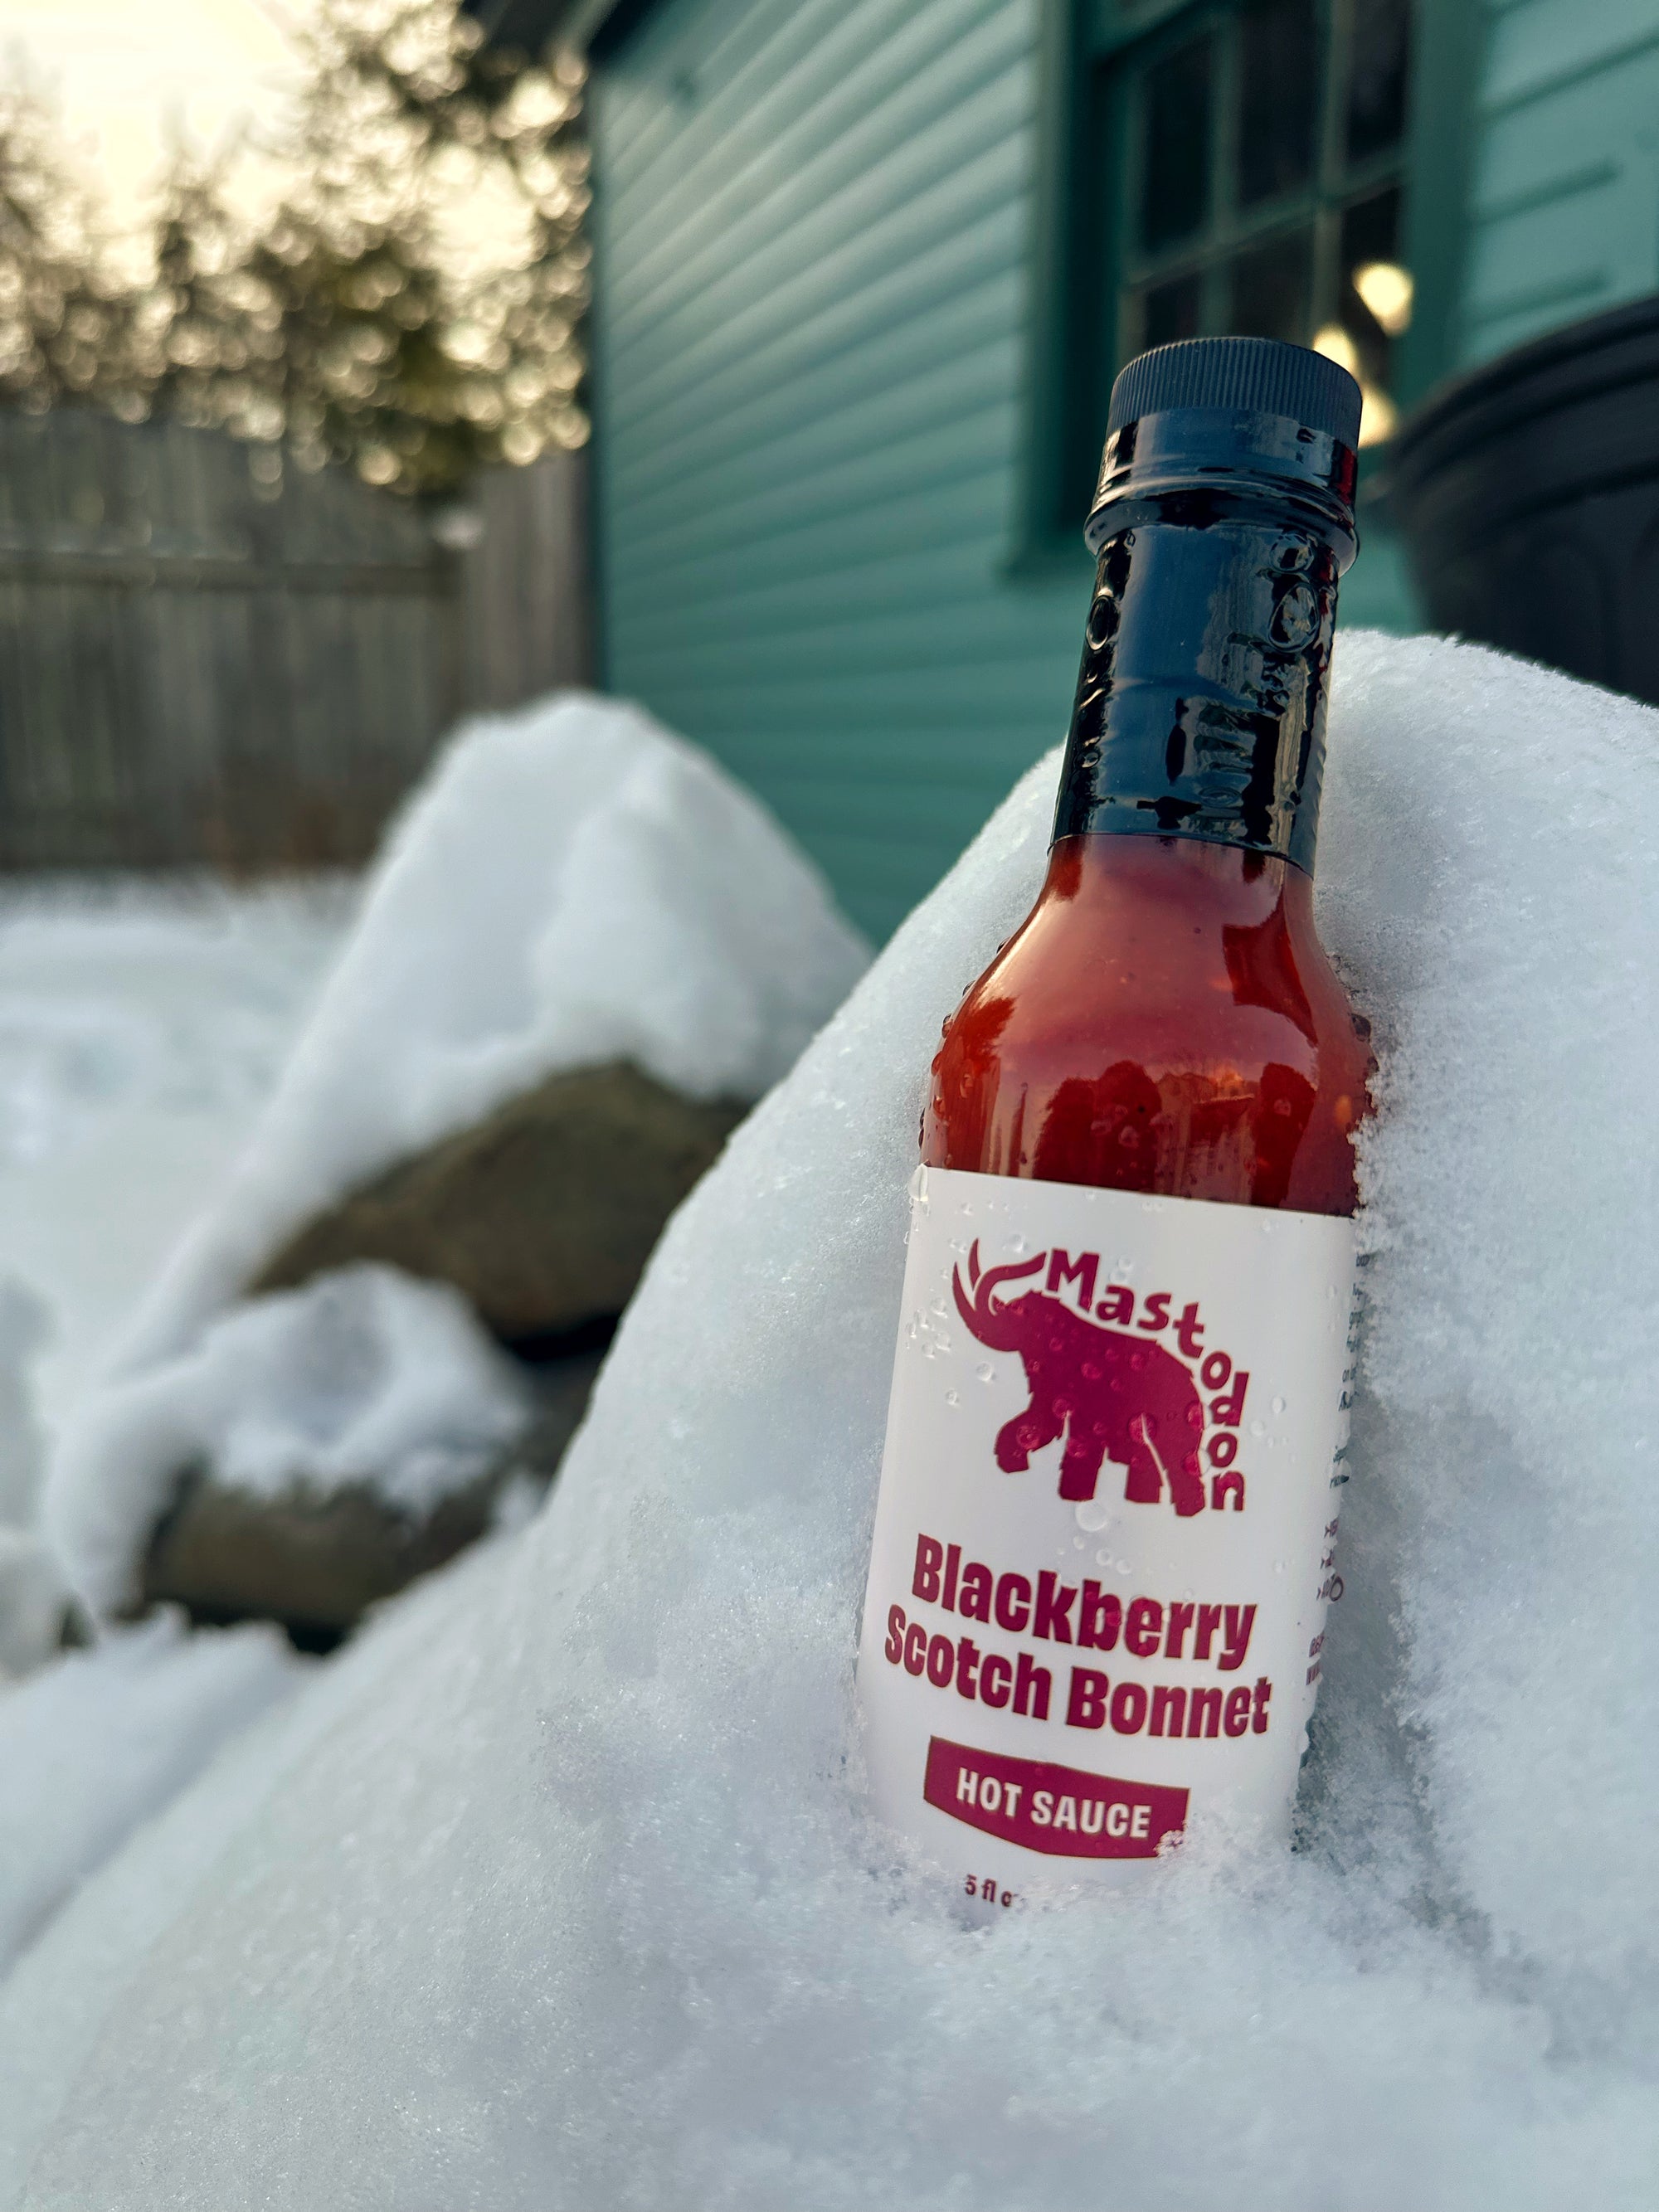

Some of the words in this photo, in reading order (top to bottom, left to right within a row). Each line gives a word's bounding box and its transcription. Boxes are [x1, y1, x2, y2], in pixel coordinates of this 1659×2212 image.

[1044, 1248, 1250, 1512] Mastodon
[912, 1532, 1258, 1671] Blackberry
[884, 1604, 1053, 1720] Scotch
[1066, 1666, 1272, 1738] Bonnet
[956, 1766, 1023, 1818] HOT
[1030, 1790, 1152, 1839] SAUCE
[964, 1874, 977, 1896] 5
[981, 1878, 996, 1903] fl
